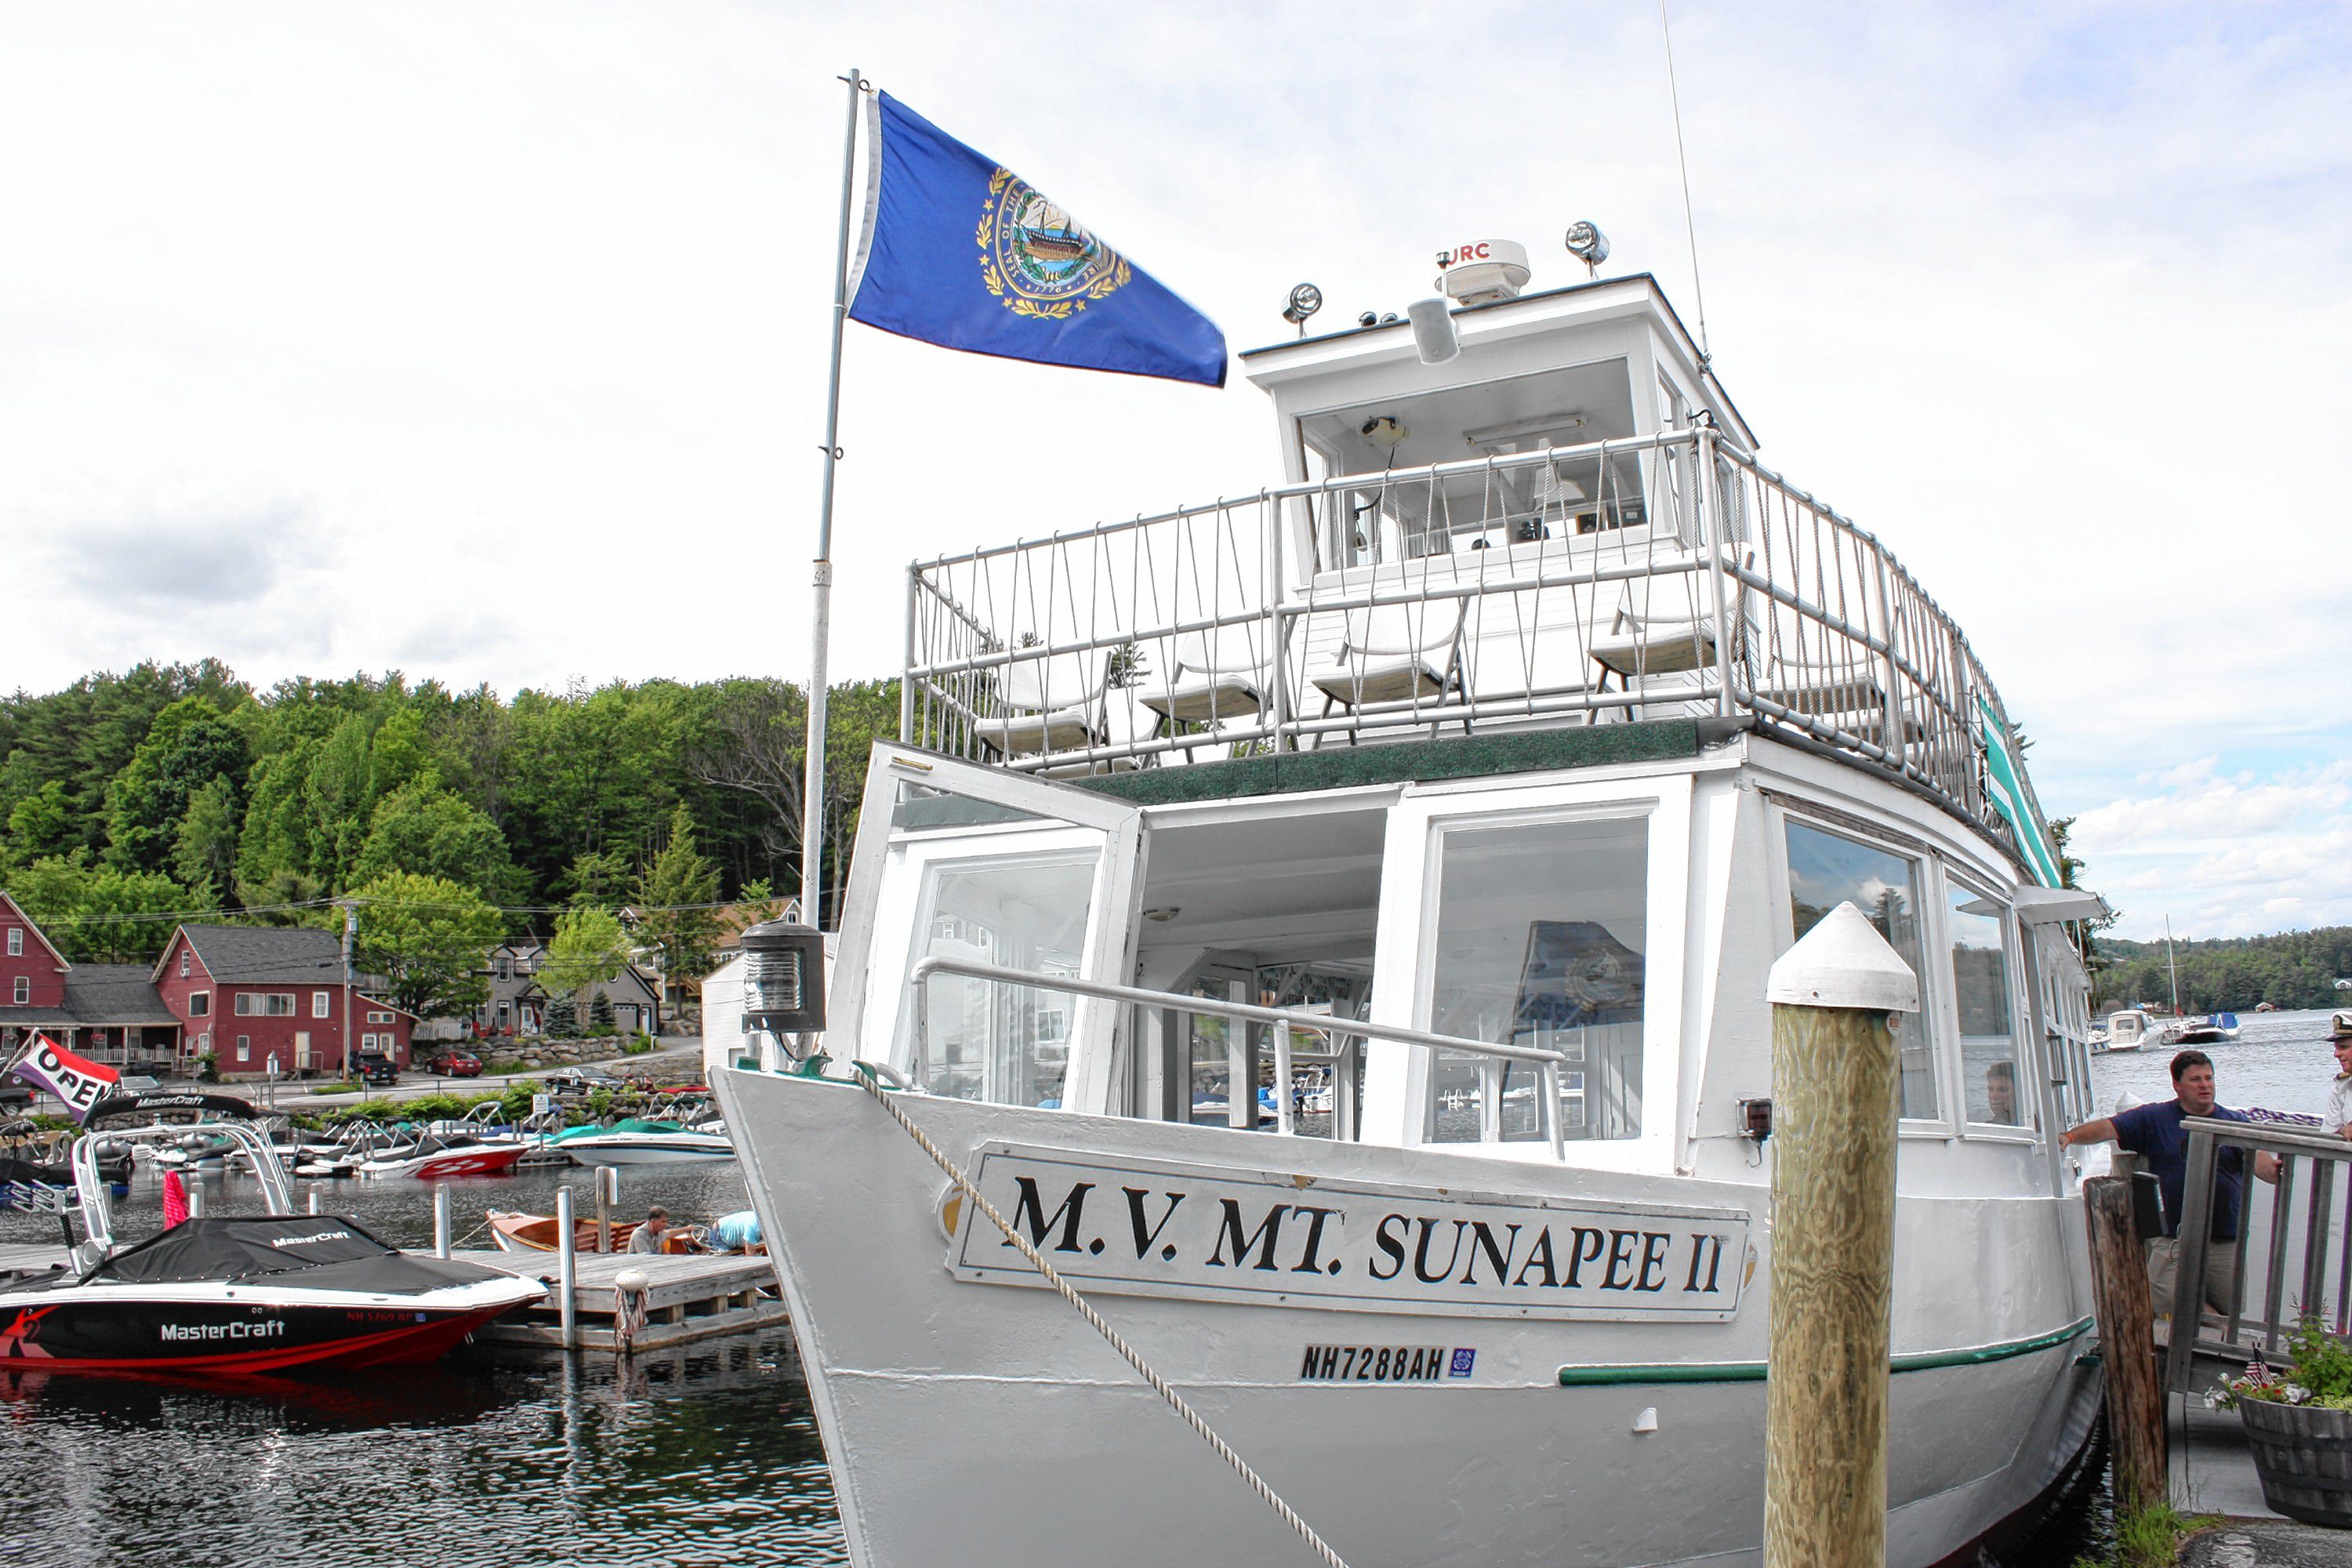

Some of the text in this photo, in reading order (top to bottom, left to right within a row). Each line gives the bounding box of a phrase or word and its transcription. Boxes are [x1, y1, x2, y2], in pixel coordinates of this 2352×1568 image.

[1002, 187, 1020, 278] SEAL OF THE
[136, 1095, 204, 1108] MasterCraft
[272, 1232, 350, 1247] MasterCraft
[1205, 1198, 1346, 1276] MT.
[1369, 1213, 1671, 1292] SUNAPEE
[1682, 1232, 1724, 1292] II
[161, 1320, 285, 1341] MasterCraft
[1301, 1346, 1444, 1381] NH7288AH
